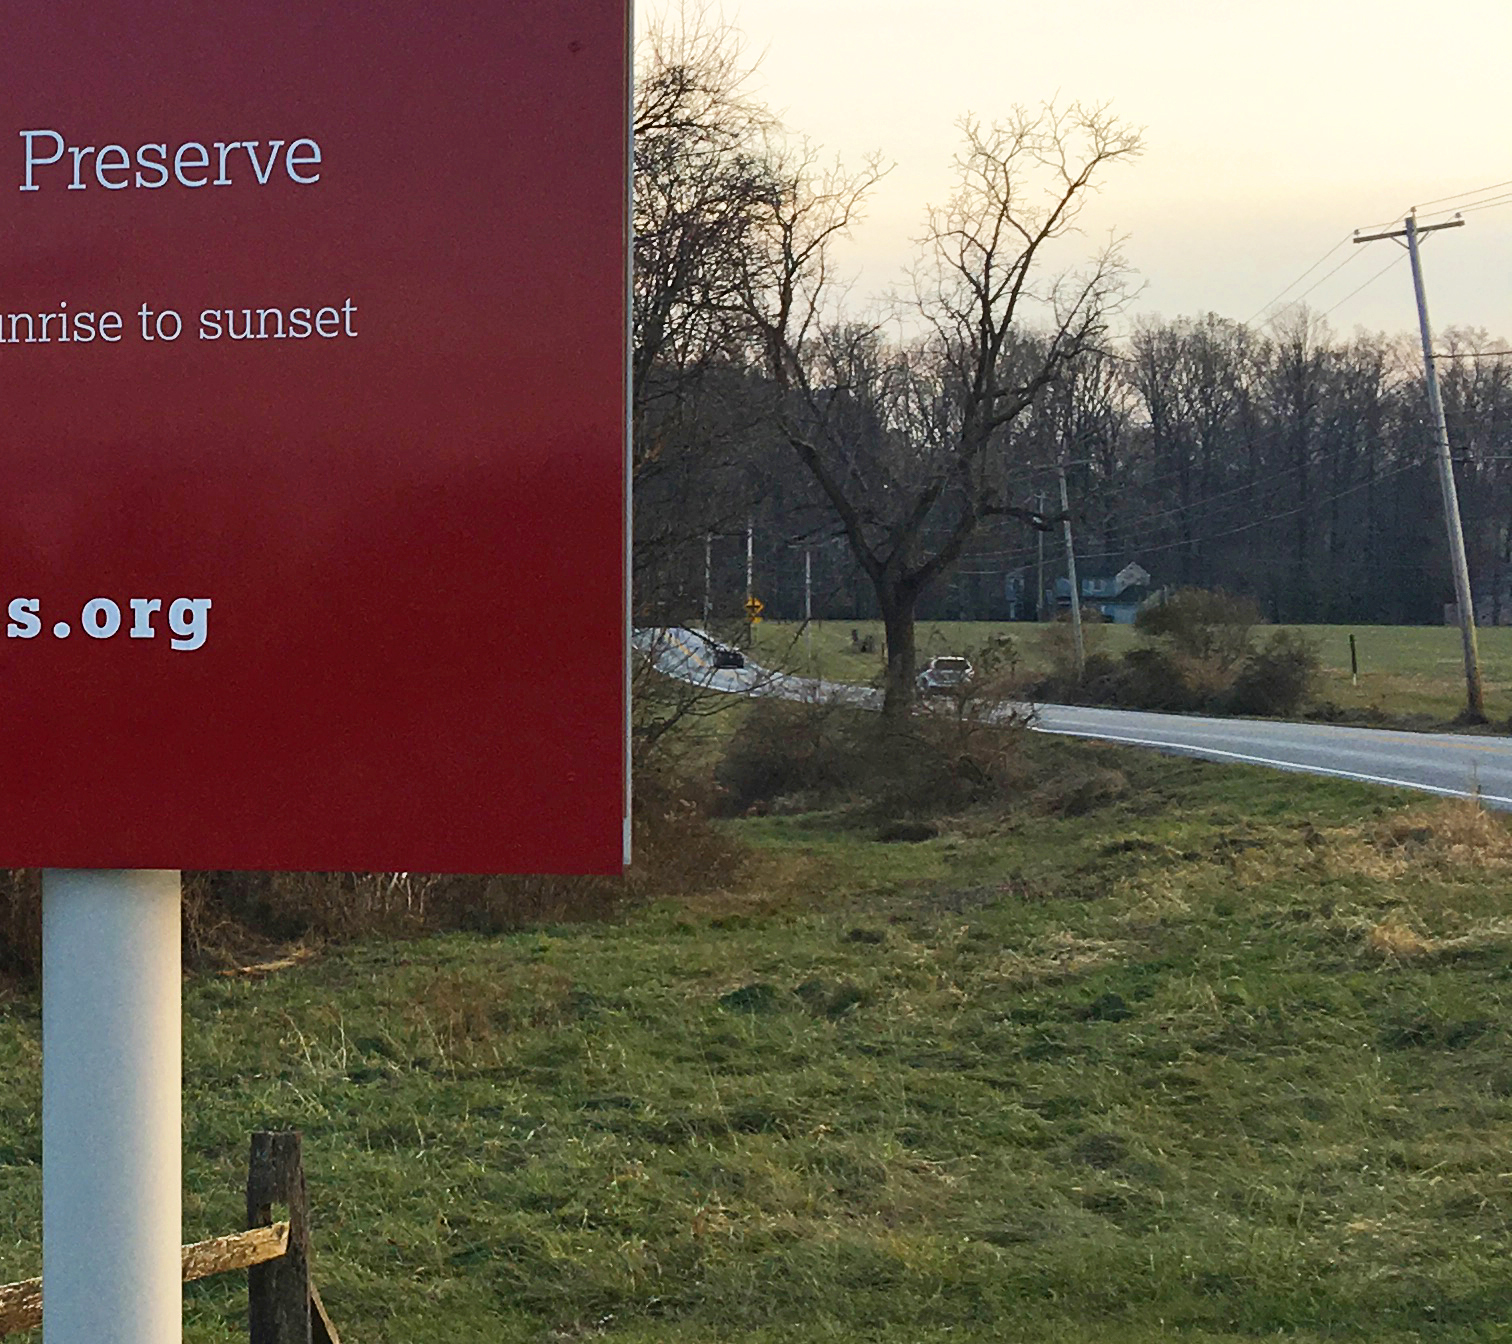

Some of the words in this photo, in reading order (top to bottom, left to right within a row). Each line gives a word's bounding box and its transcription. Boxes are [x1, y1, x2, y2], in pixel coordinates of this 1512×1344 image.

[18, 128, 323, 192] Preserve
[136, 301, 184, 342] to
[198, 296, 360, 341] sunset
